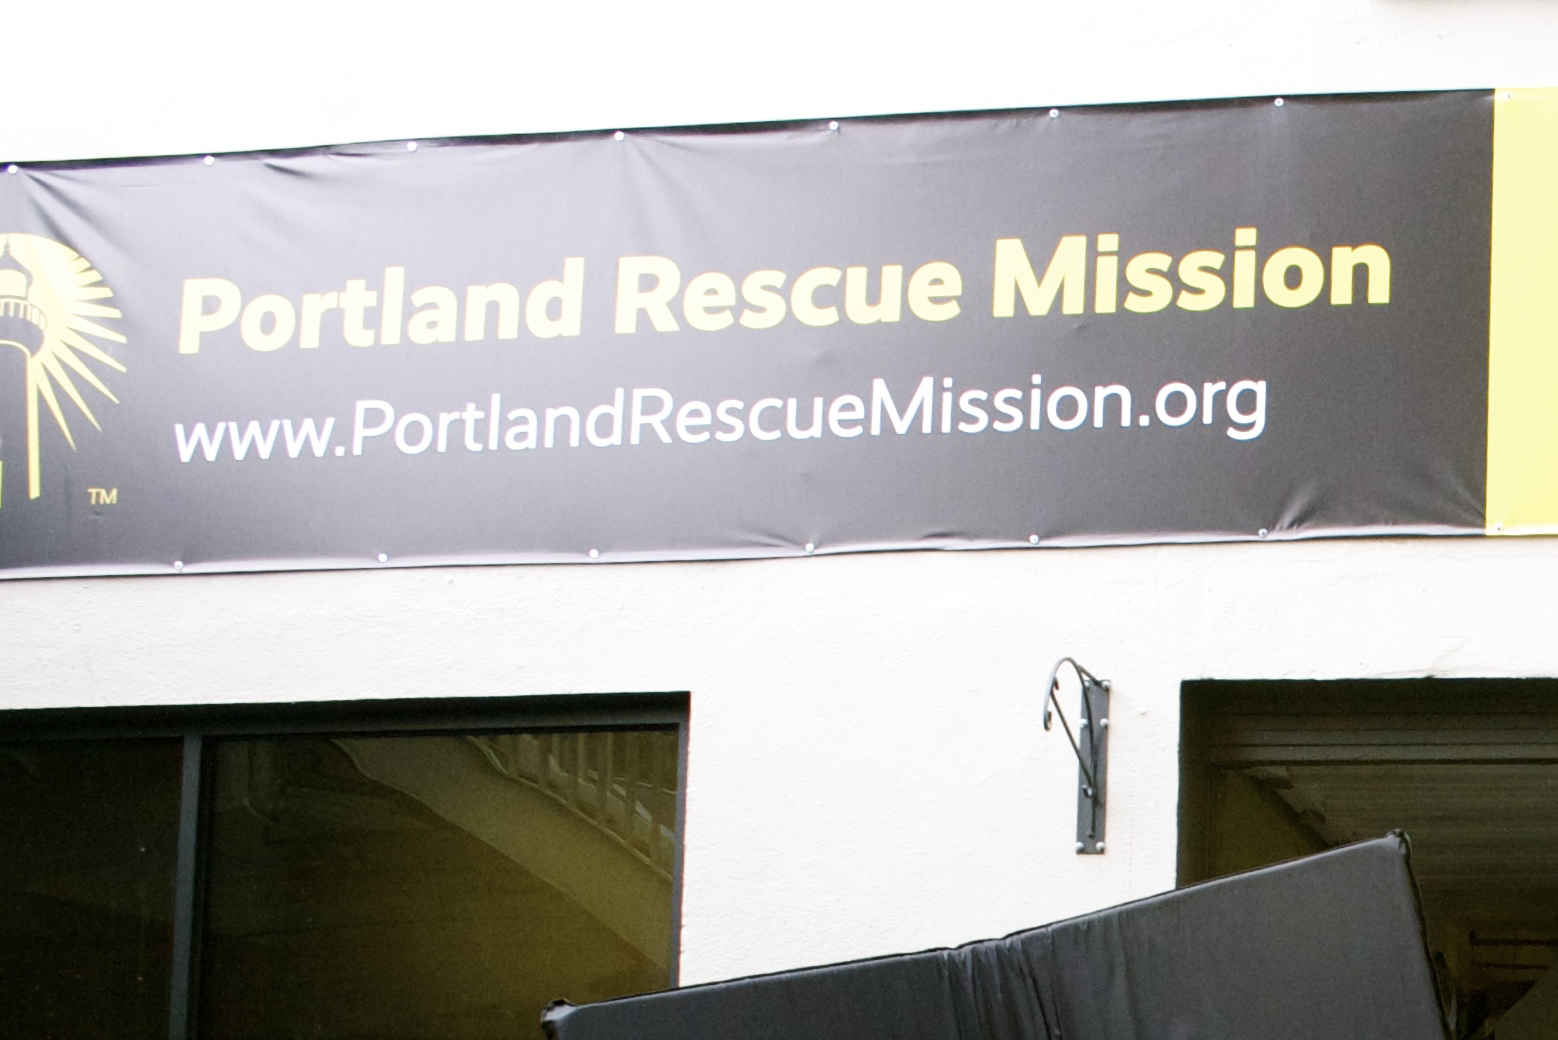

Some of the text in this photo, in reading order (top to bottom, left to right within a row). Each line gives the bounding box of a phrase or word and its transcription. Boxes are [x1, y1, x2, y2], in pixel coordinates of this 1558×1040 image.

[178, 228, 1391, 355] Portland Rescue Mission
[173, 373, 1268, 463] www.PortlandRescueMission.org
[87, 487, 118, 505] TM
